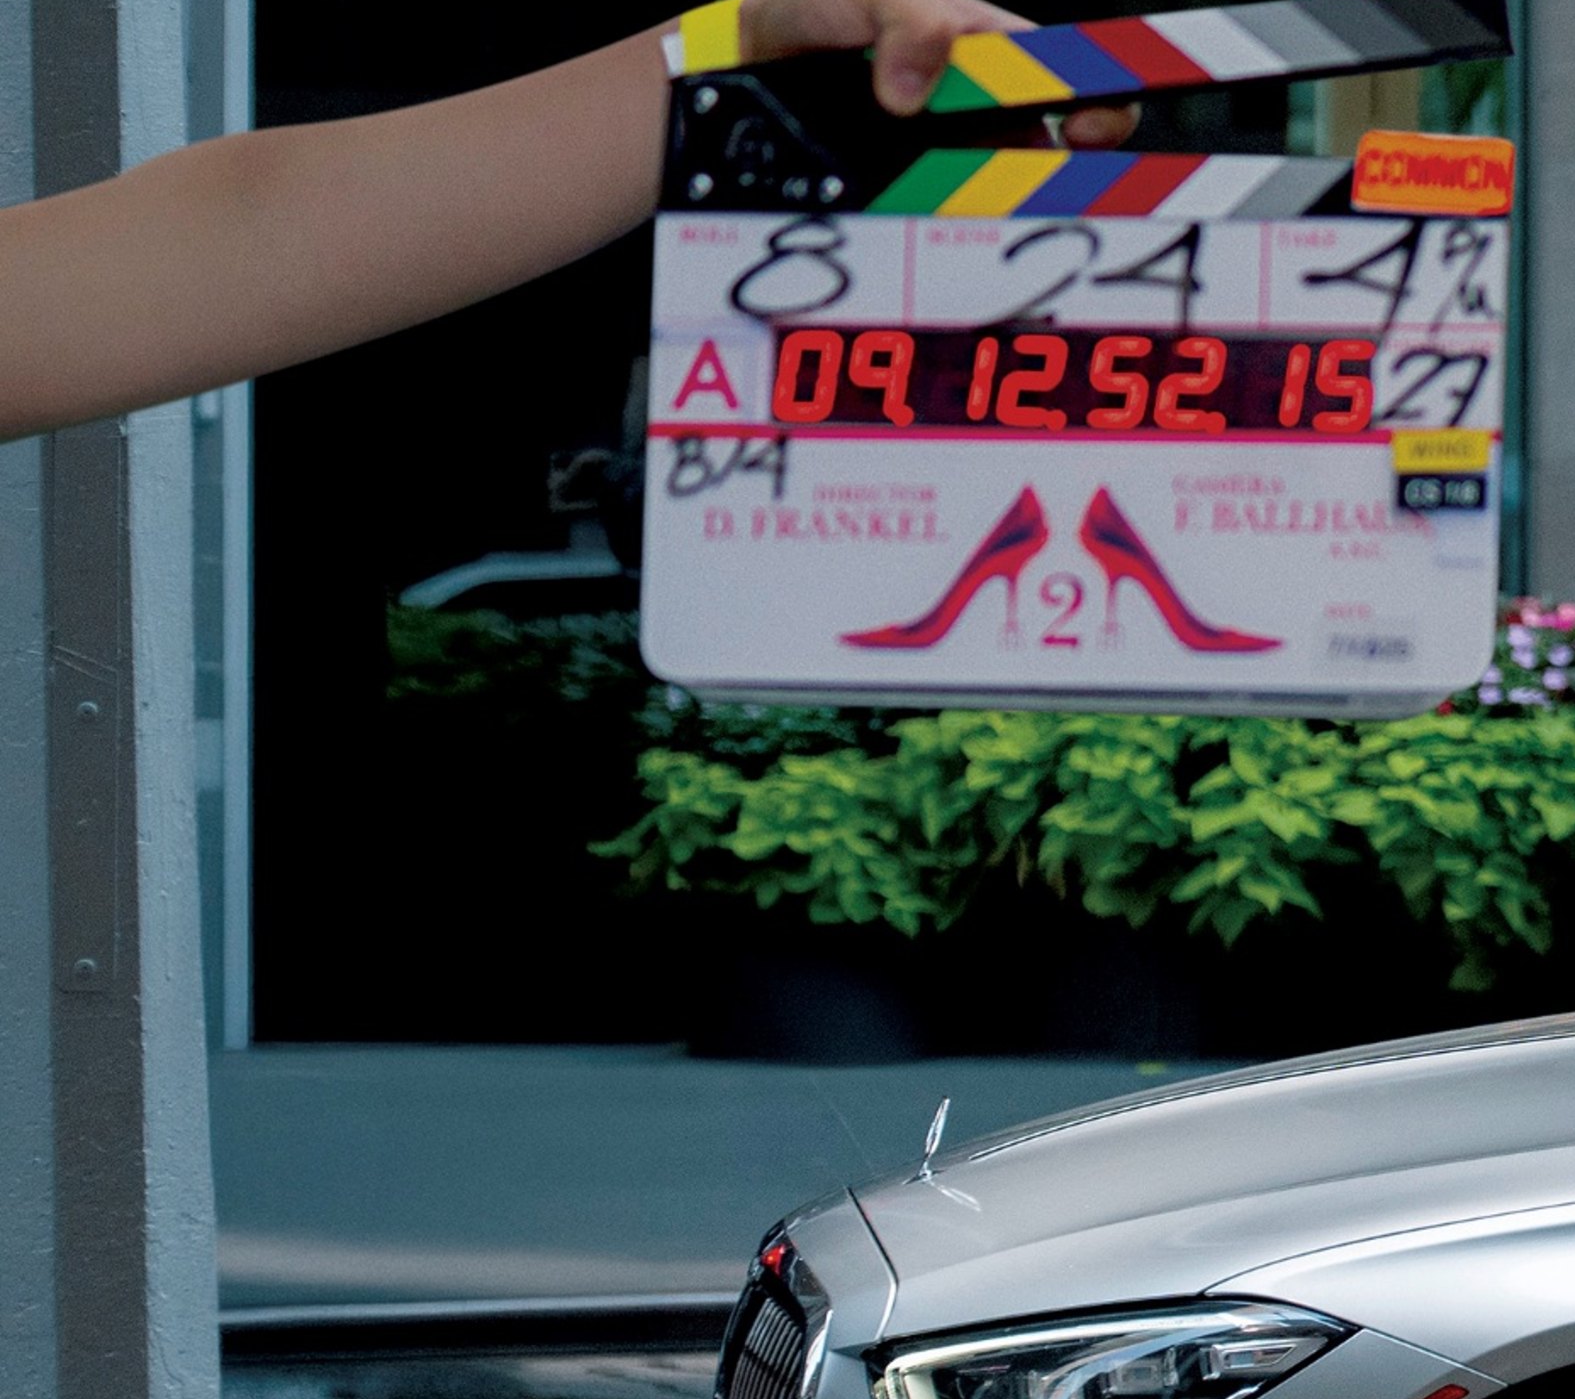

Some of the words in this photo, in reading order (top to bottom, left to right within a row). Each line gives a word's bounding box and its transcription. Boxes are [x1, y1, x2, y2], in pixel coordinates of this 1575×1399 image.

[1358, 147, 1508, 191] COMMON
[729, 212, 852, 322] 8
[968, 219, 1204, 335] 24
[671, 337, 741, 411] A
[1381, 347, 1489, 430] 27
[751, 504, 950, 544] FRANKEL
[1037, 571, 1085, 648] 2
